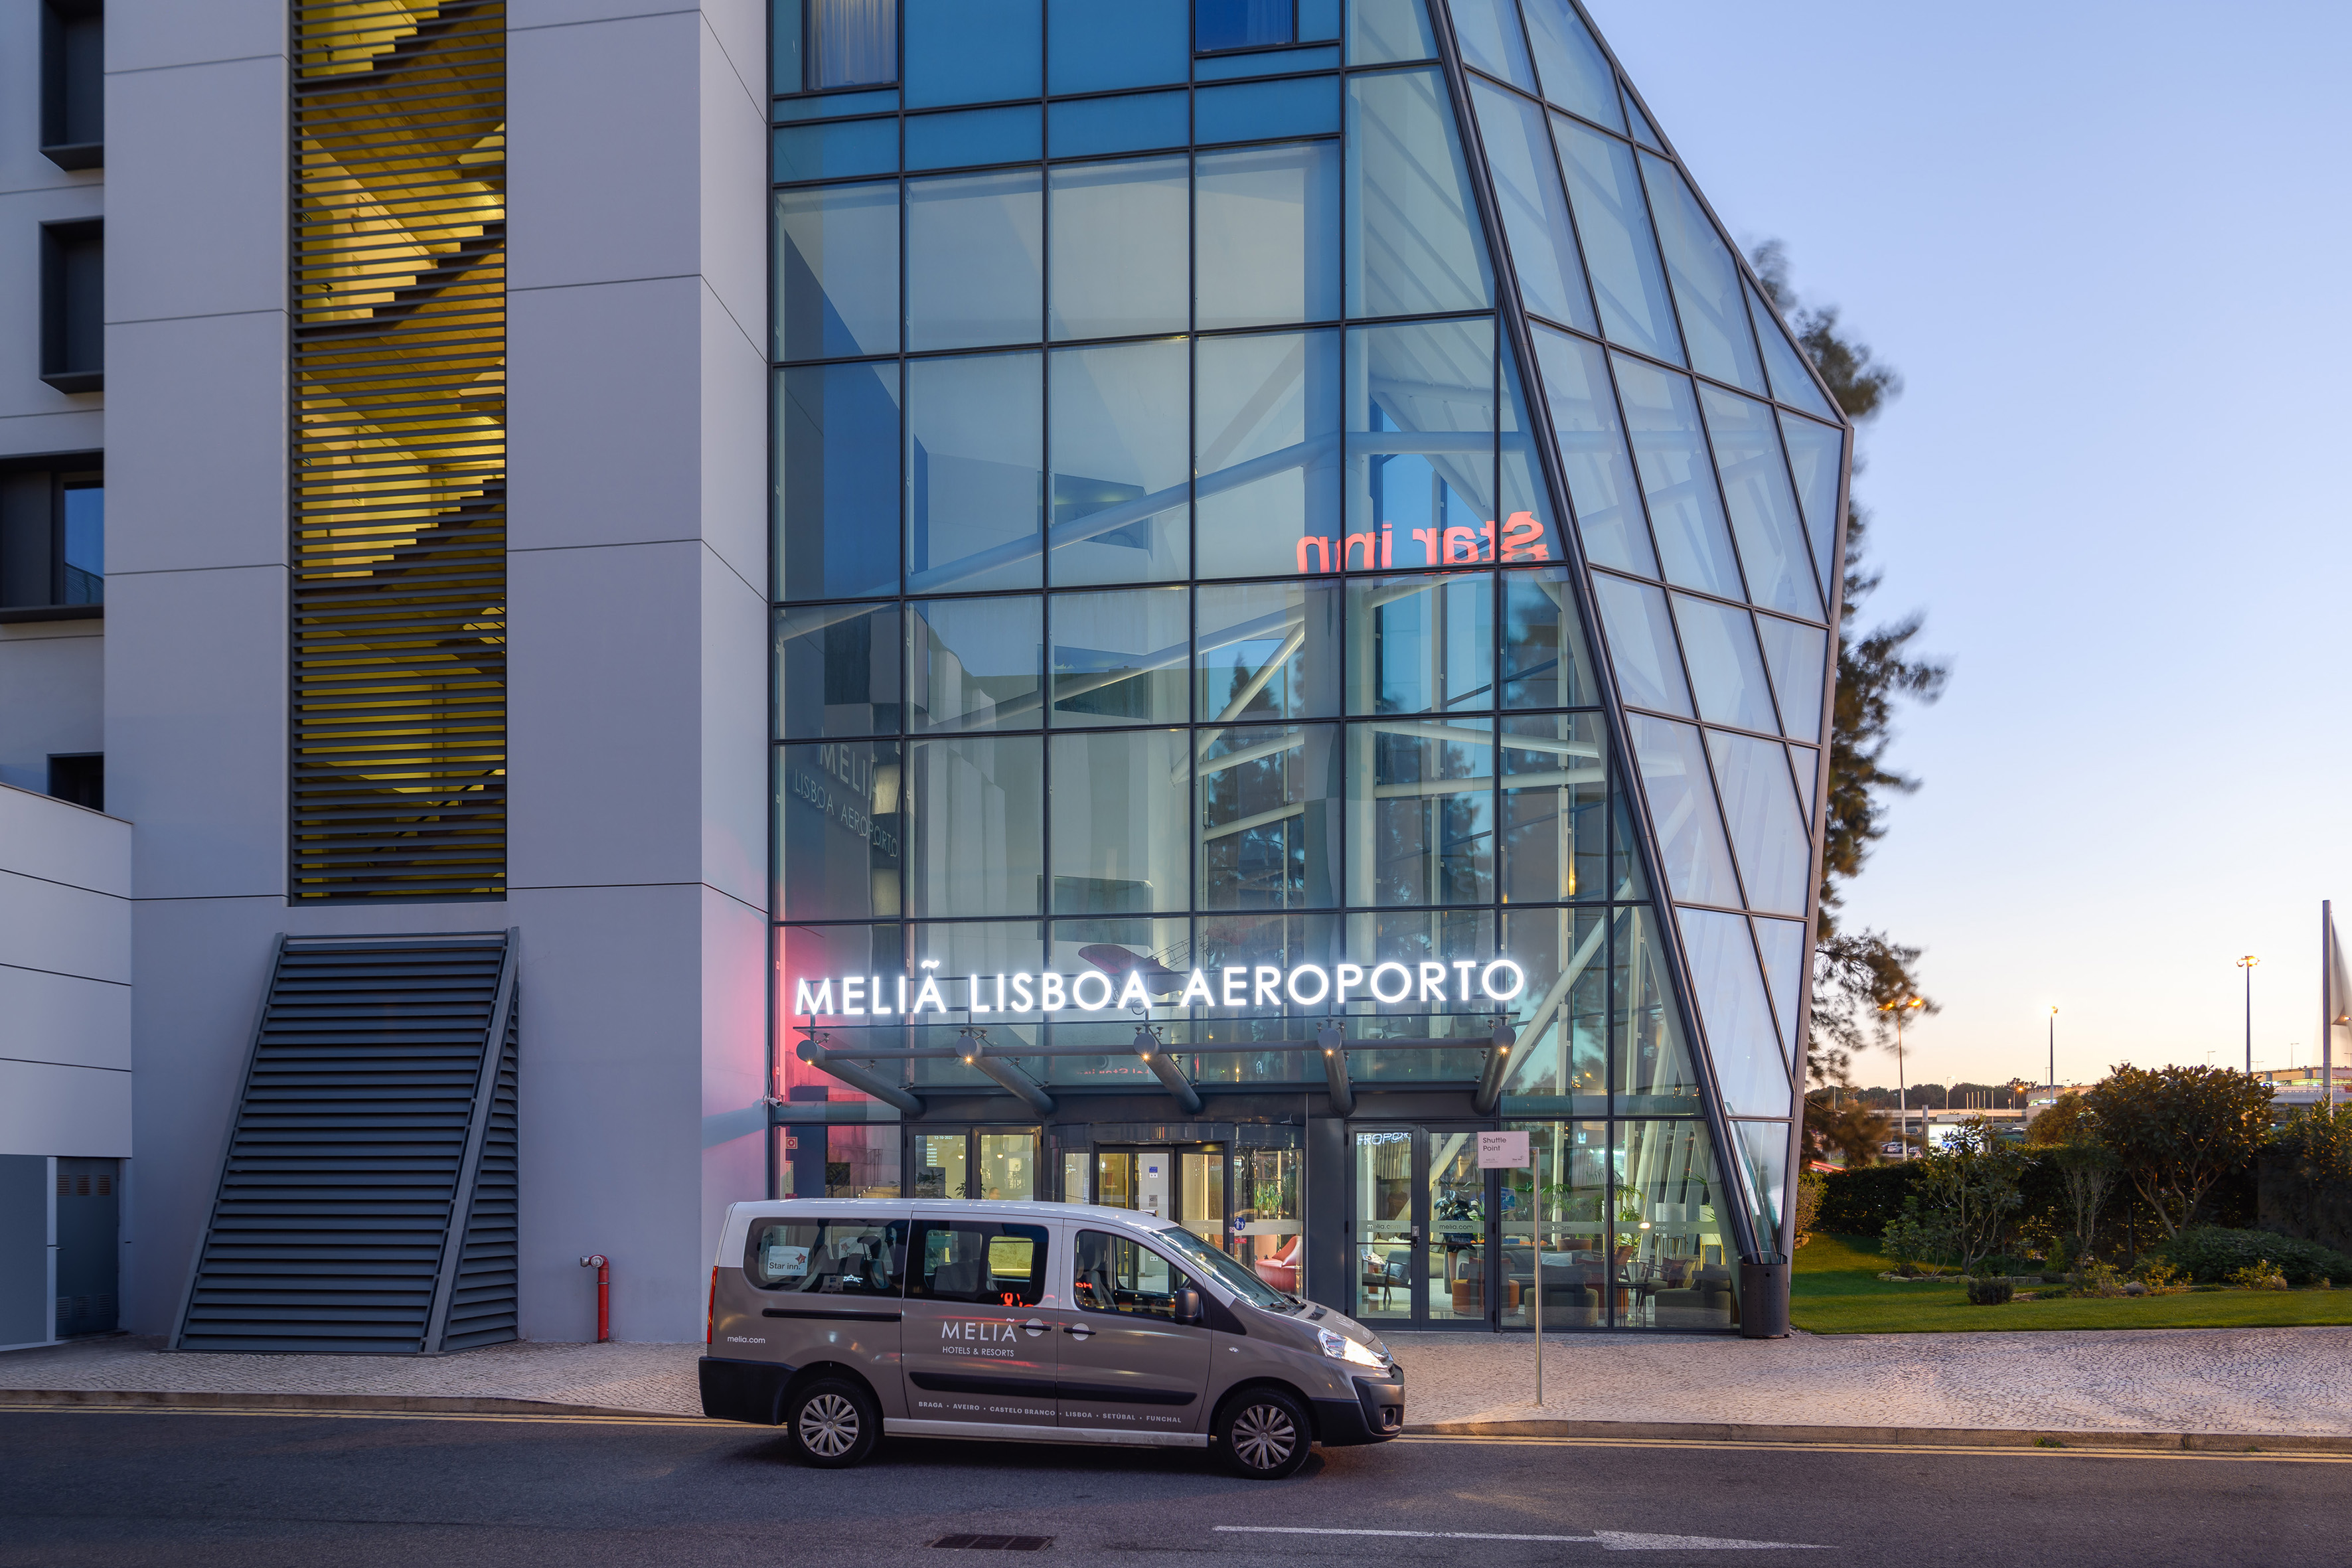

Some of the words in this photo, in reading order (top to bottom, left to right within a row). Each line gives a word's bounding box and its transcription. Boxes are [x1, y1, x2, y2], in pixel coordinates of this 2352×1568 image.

[795, 769, 834, 815] LISBOA
[840, 803, 898, 857] AEROPORTO
[795, 960, 947, 1016] MELIÃ
[969, 969, 1152, 1013] LISBOA
[1179, 959, 1525, 1007] AEROPORTO
[941, 1318, 1017, 1342] MELIÃ
[943, 1346, 971, 1355] HOTELS
[982, 1348, 1014, 1357] RESORTS
